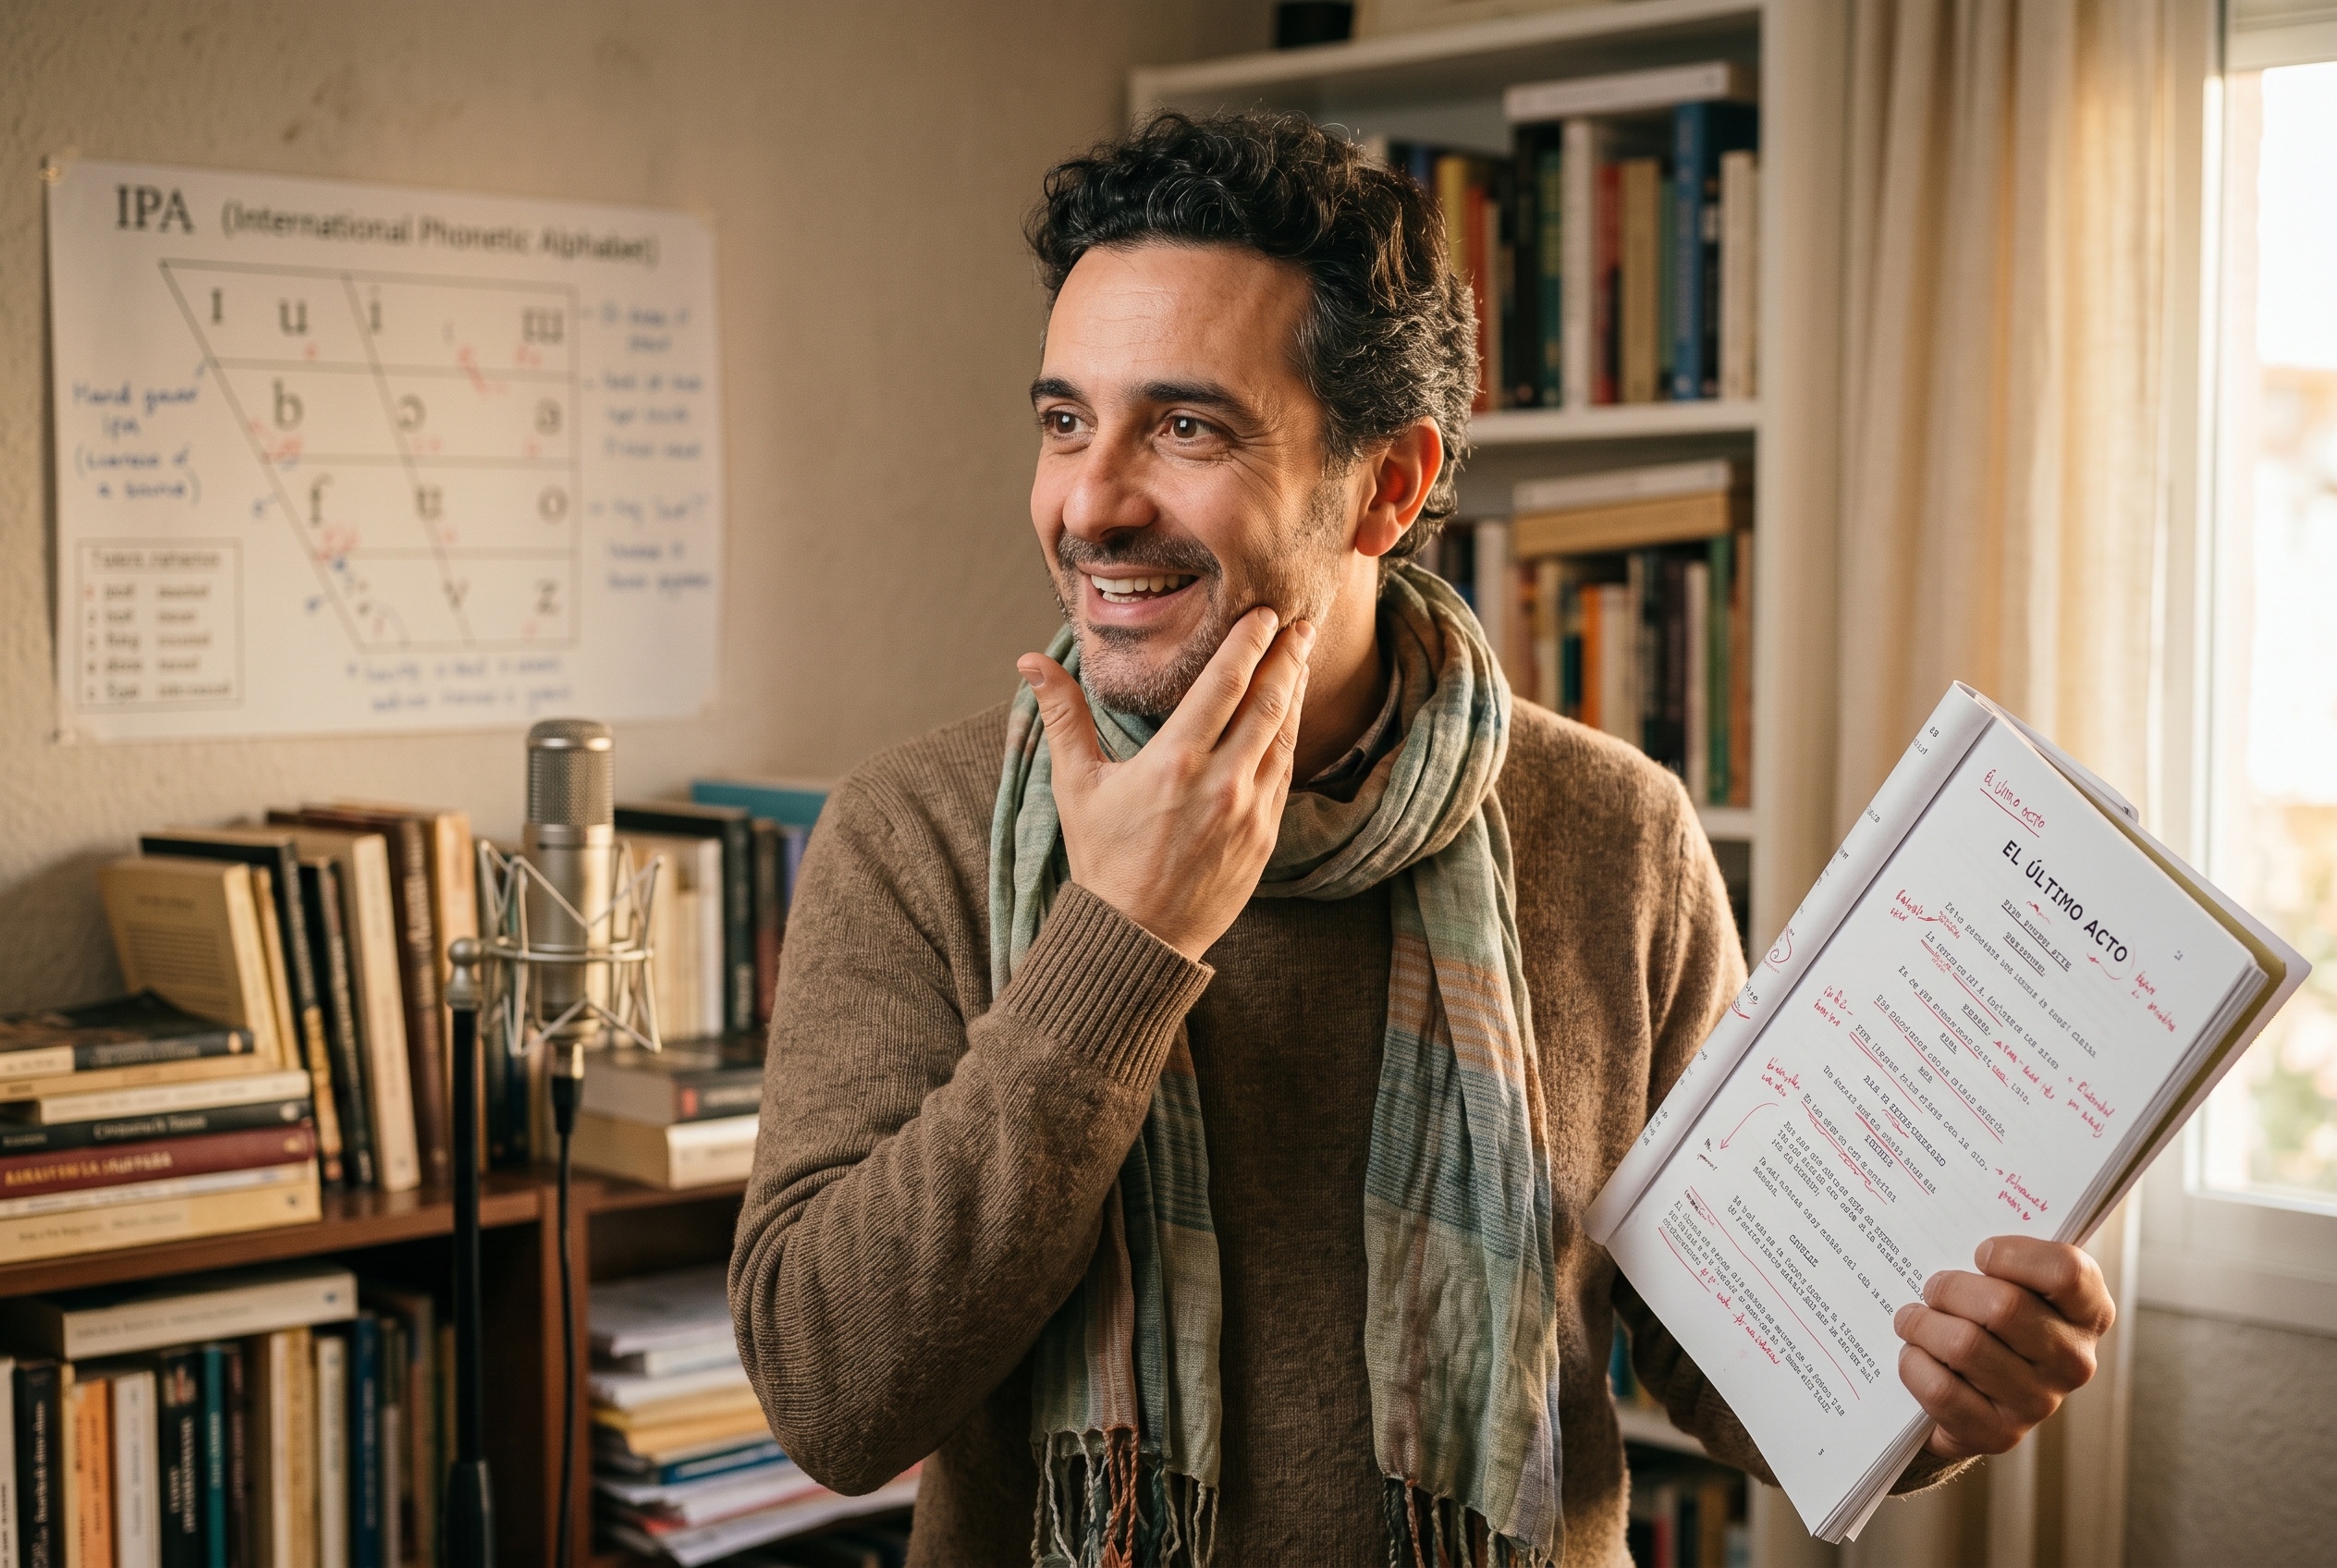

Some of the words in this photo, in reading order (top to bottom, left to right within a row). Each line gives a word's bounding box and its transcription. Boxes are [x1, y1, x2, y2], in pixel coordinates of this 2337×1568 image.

[116, 183, 194, 235] IPA
[221, 198, 414, 248] (International
[418, 214, 529, 255] Phonetic
[2002, 839, 2022, 865] EL
[2025, 859, 2084, 921] ÚLTIMO
[2083, 920, 2128, 962] ACTO
